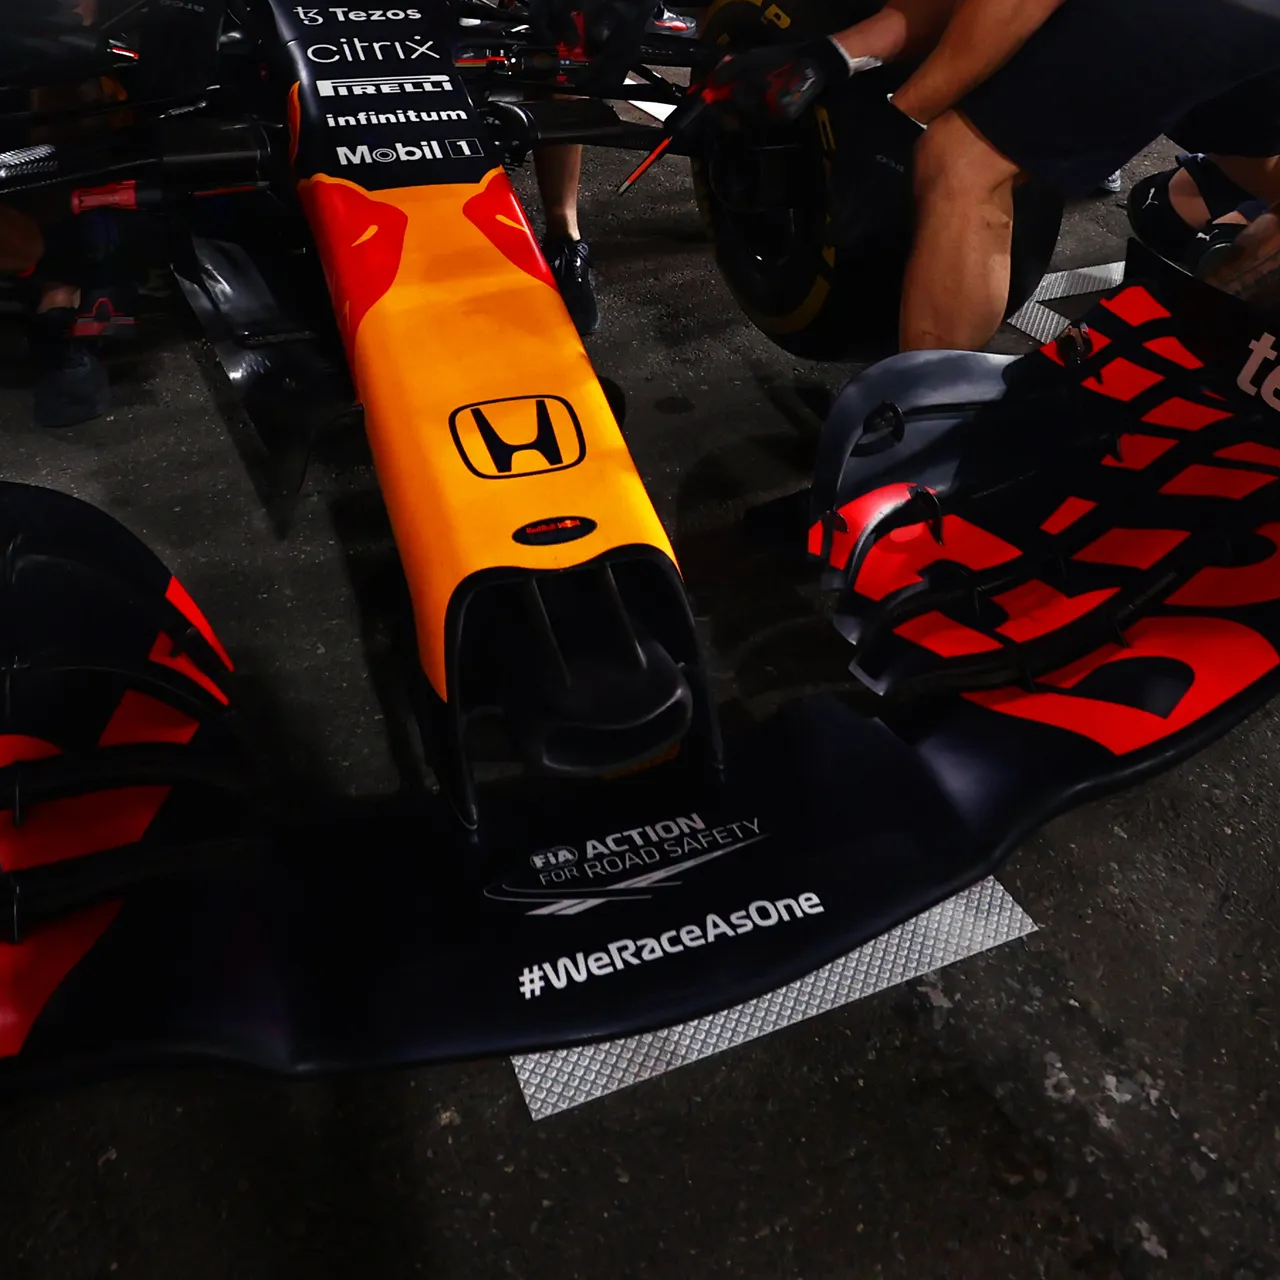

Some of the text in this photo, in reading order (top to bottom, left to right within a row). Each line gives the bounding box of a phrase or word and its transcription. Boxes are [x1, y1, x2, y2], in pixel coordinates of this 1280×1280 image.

[329, 7, 422, 22] Tezos
[307, 36, 440, 63] citrix
[316, 75, 453, 96] PIRELLI
[326, 110, 468, 127] infinitum
[336, 141, 443, 165] Mobil
[586, 813, 706, 858] ACTION
[539, 818, 760, 885] FOR ROAD SAFETY
[519, 892, 825, 999] #WeRaceAsOne
